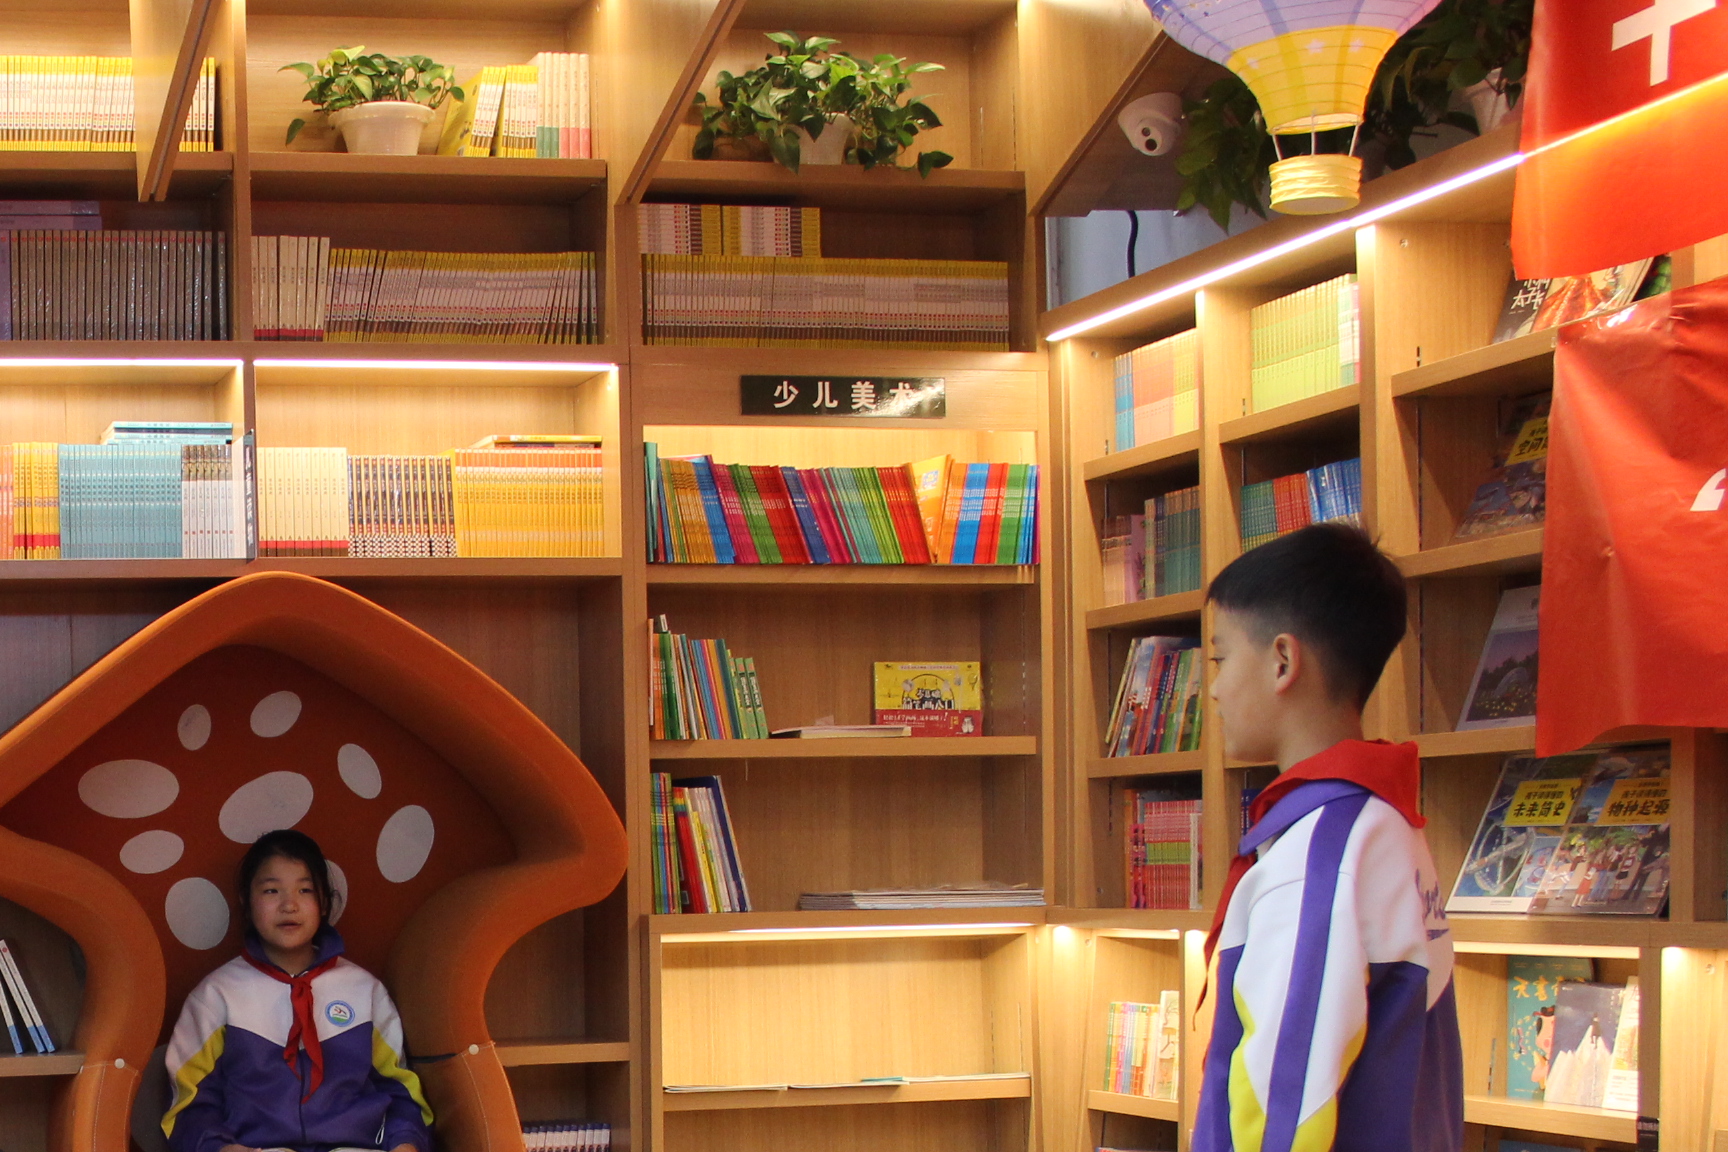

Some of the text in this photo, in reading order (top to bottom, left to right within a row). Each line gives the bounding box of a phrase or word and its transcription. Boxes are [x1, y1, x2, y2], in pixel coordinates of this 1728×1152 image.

[773, 380, 918, 409] 少儿美术
[1513, 801, 1566, 817] 未来简史
[1607, 799, 1670, 817] 物种起源
